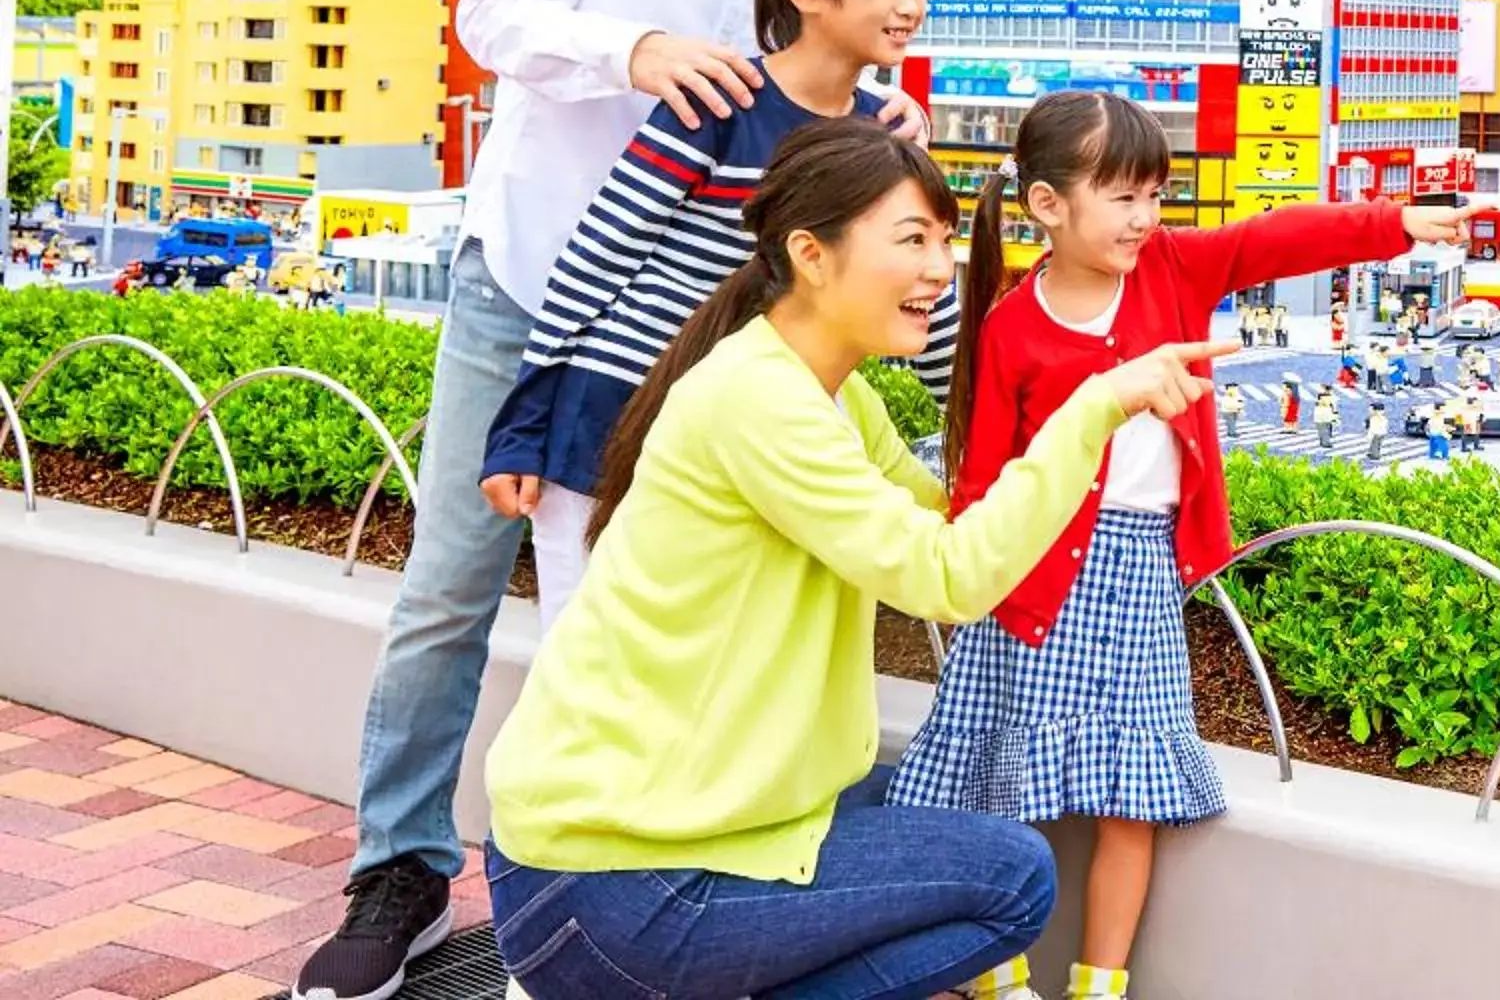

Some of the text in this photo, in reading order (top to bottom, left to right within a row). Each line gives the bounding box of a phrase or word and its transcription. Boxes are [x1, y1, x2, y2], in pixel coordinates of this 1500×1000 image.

[1250, 41, 1273, 51] THE
[1243, 53, 1283, 69] ONE
[1249, 69, 1317, 85] PULSE
[332, 207, 375, 221] TOKYO
